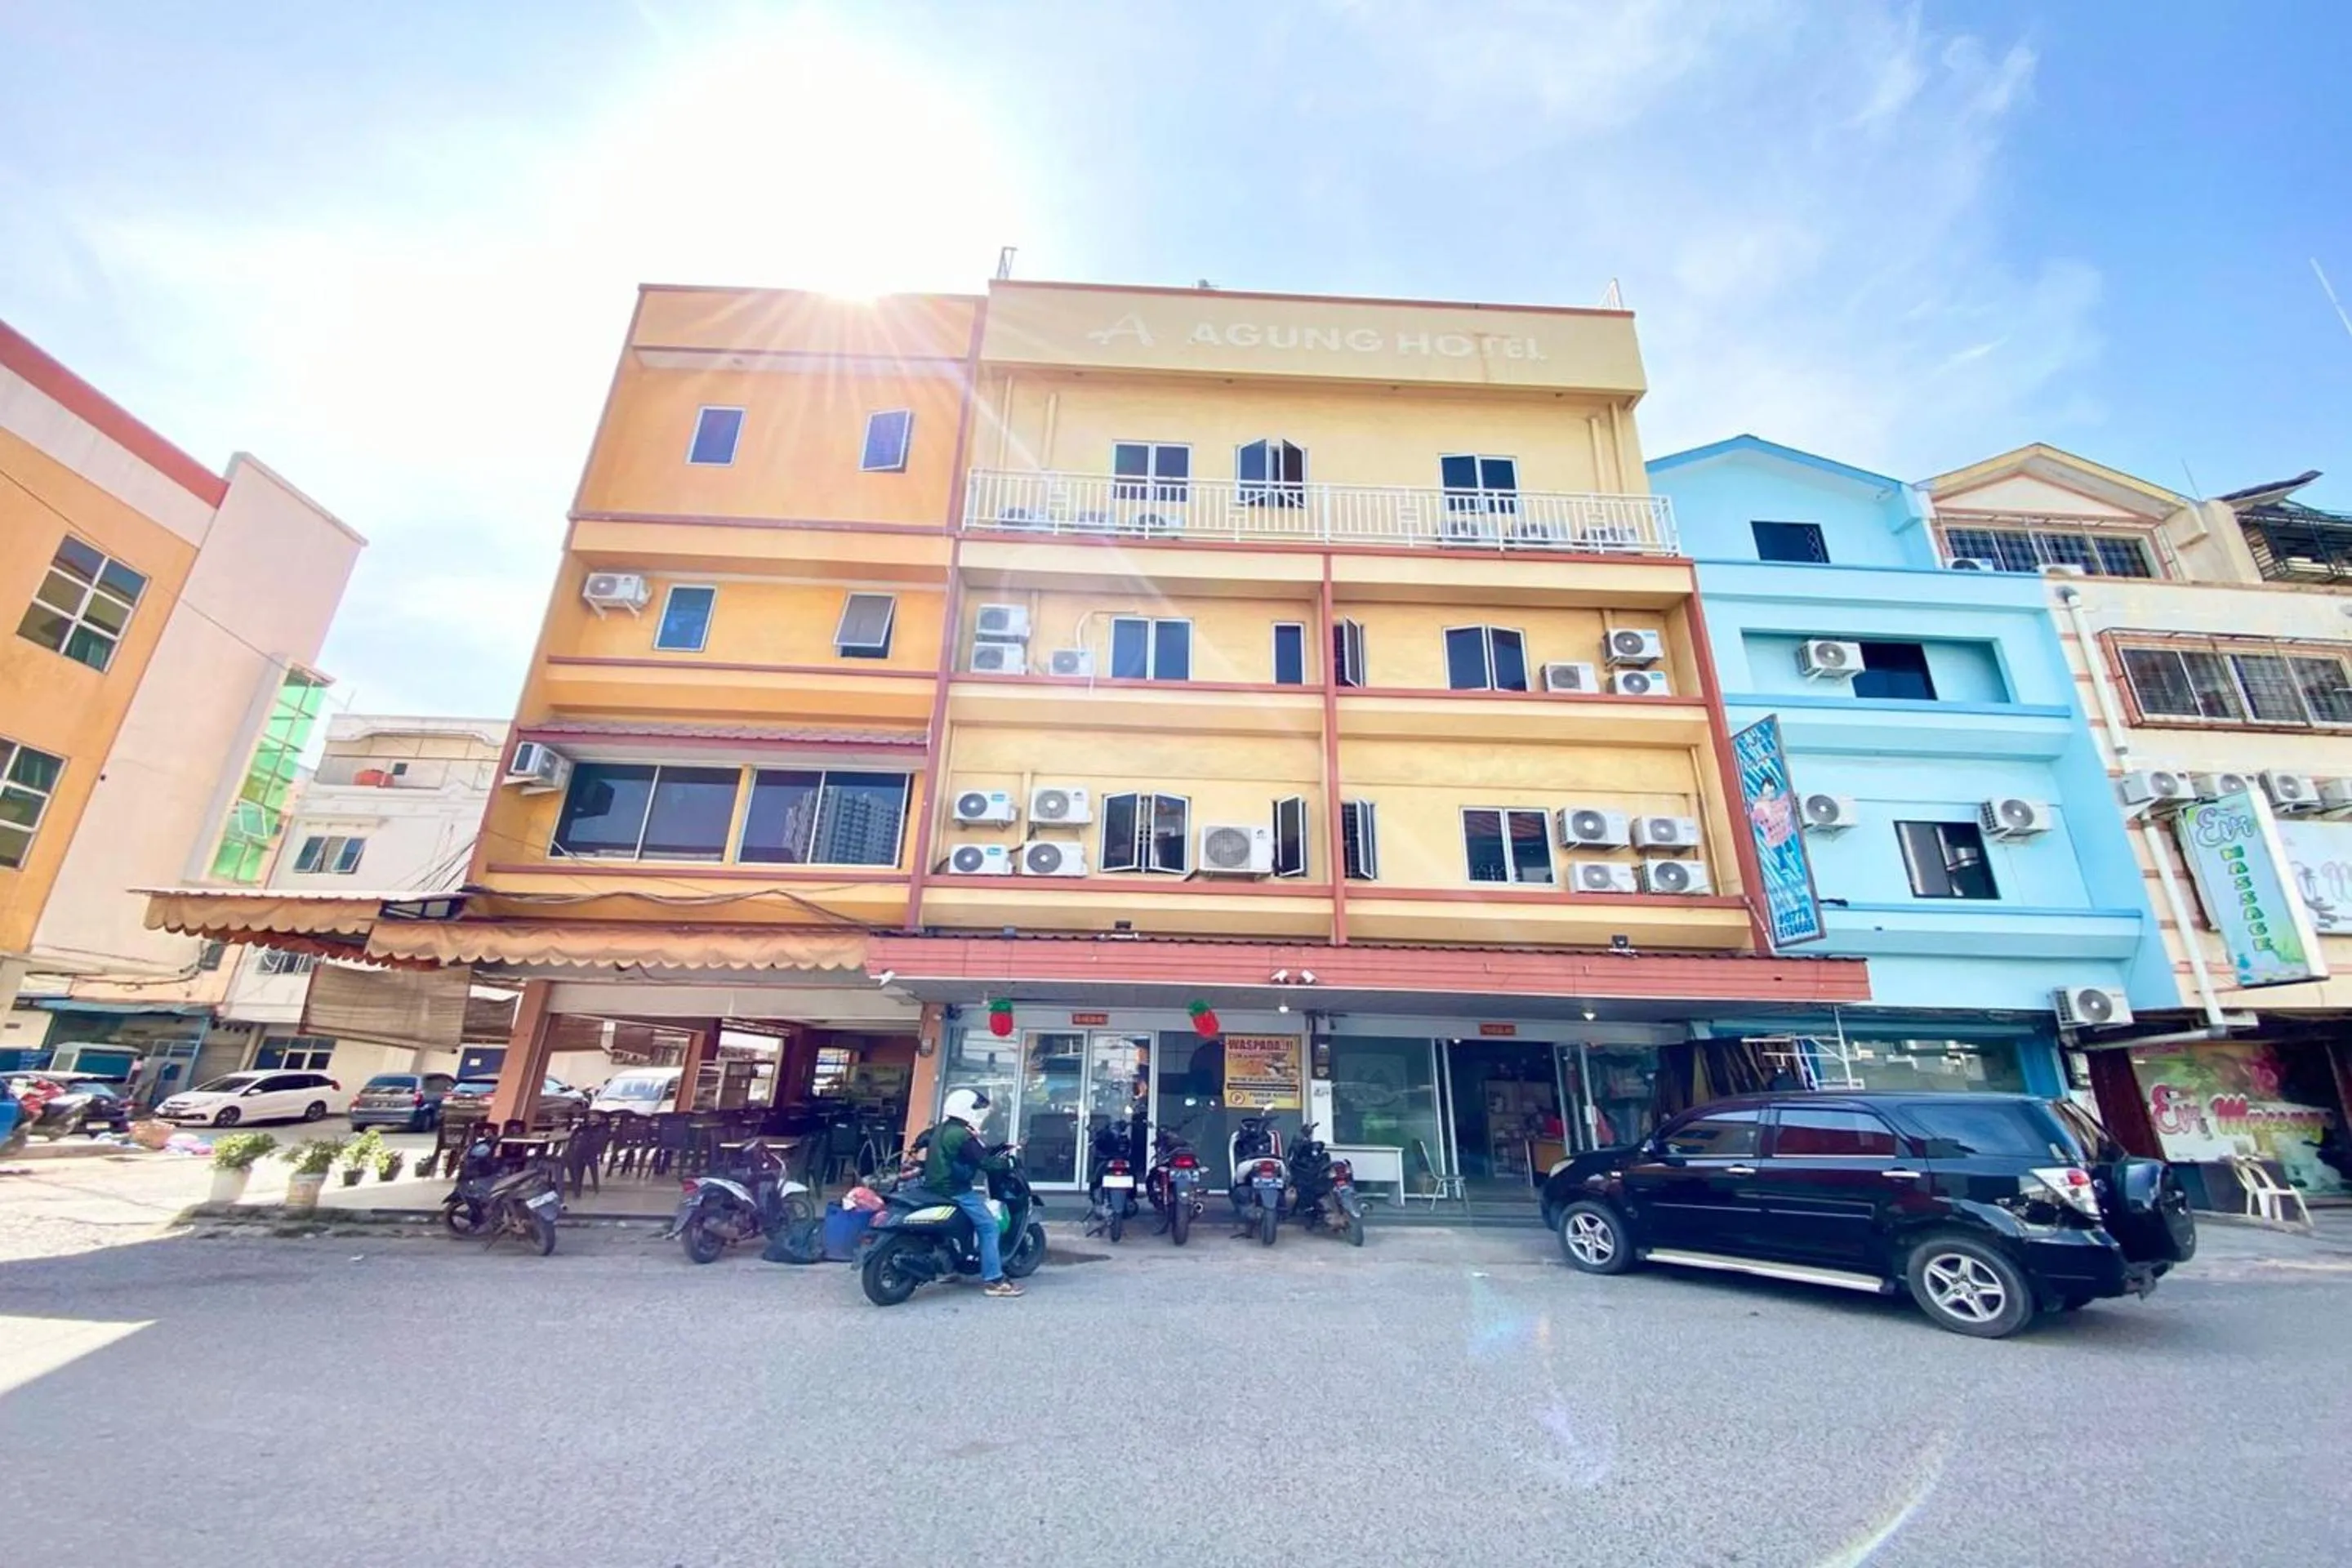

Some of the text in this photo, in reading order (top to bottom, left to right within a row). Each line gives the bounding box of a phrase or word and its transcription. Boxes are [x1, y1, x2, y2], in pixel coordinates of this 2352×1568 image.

[1187, 323, 1383, 352] AGUNG
[1396, 330, 1548, 360] HOTEL
[2220, 844, 2274, 951] MASSAGE
